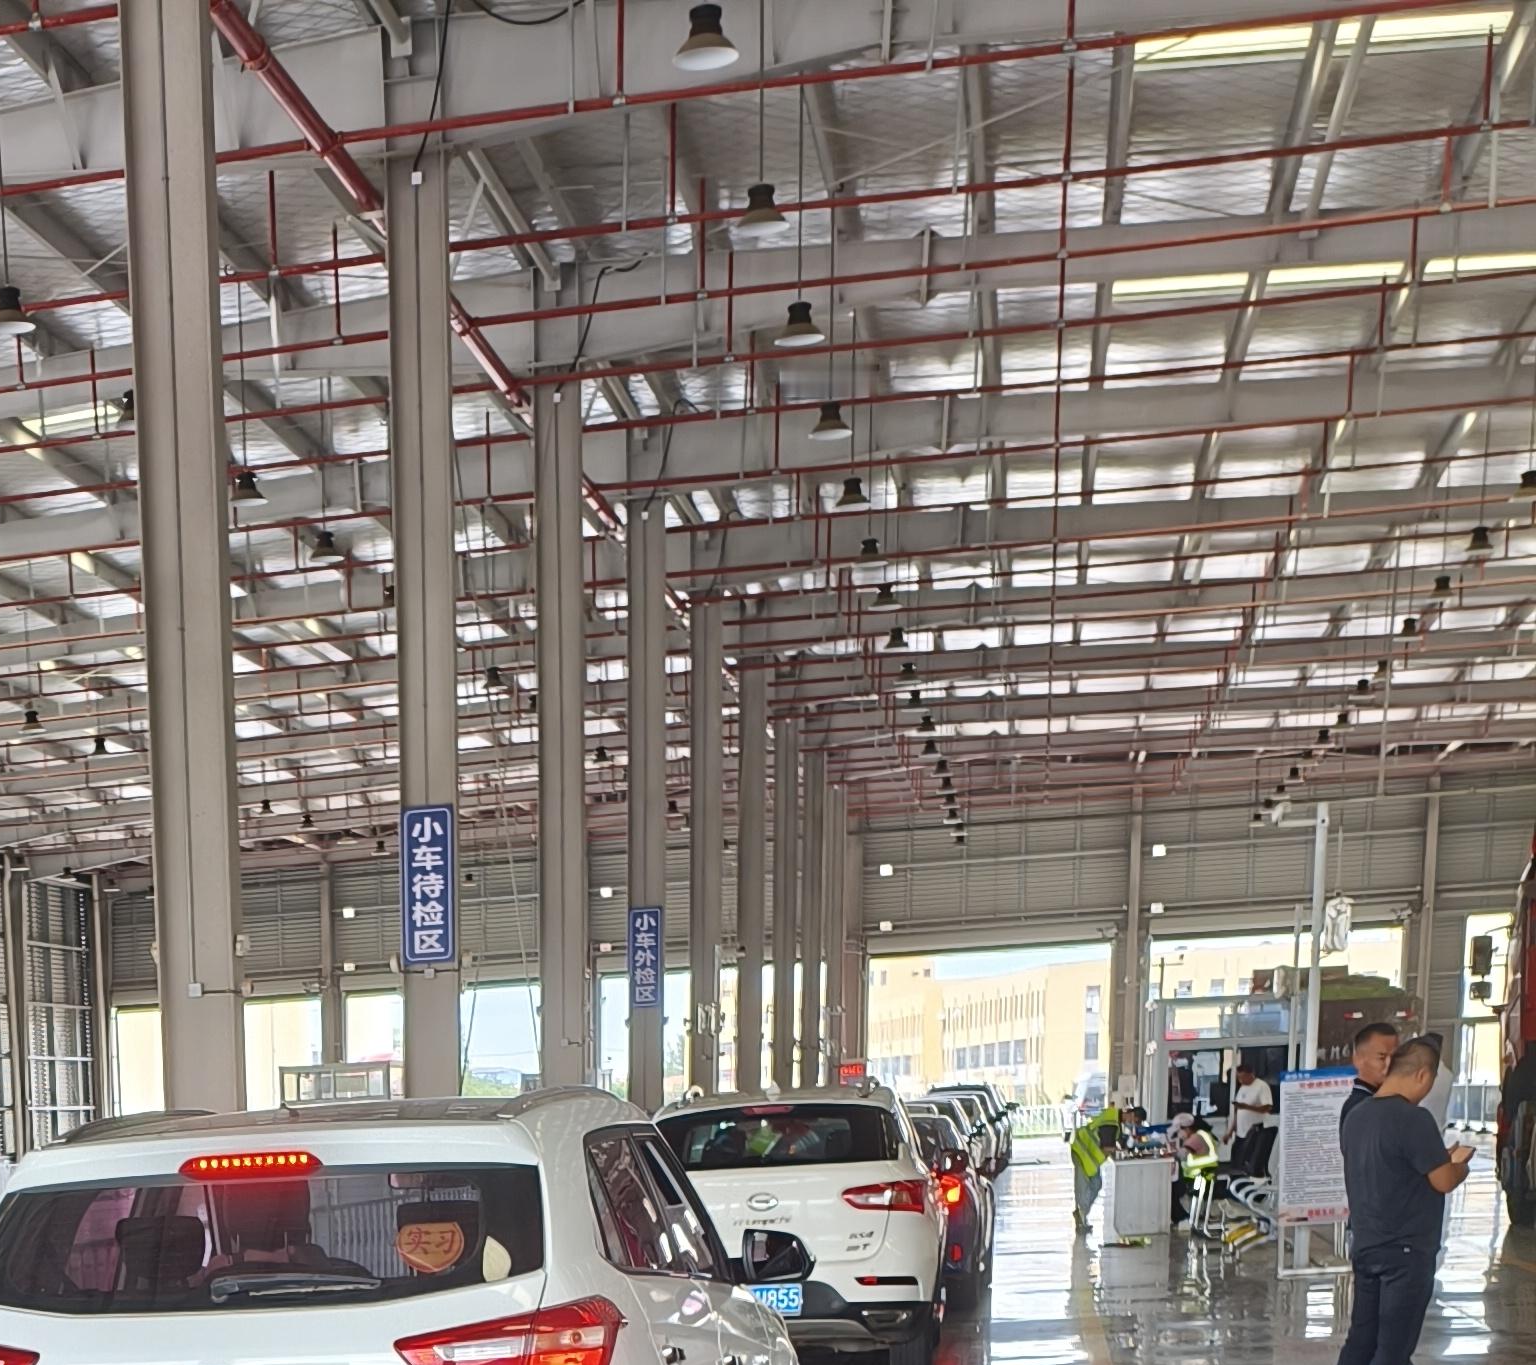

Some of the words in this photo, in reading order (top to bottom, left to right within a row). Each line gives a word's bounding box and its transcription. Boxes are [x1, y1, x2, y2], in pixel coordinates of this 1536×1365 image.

[411, 816, 445, 954] 小车待检区
[634, 913, 657, 1003] 小车外检区
[407, 1226, 456, 1255] 实习
